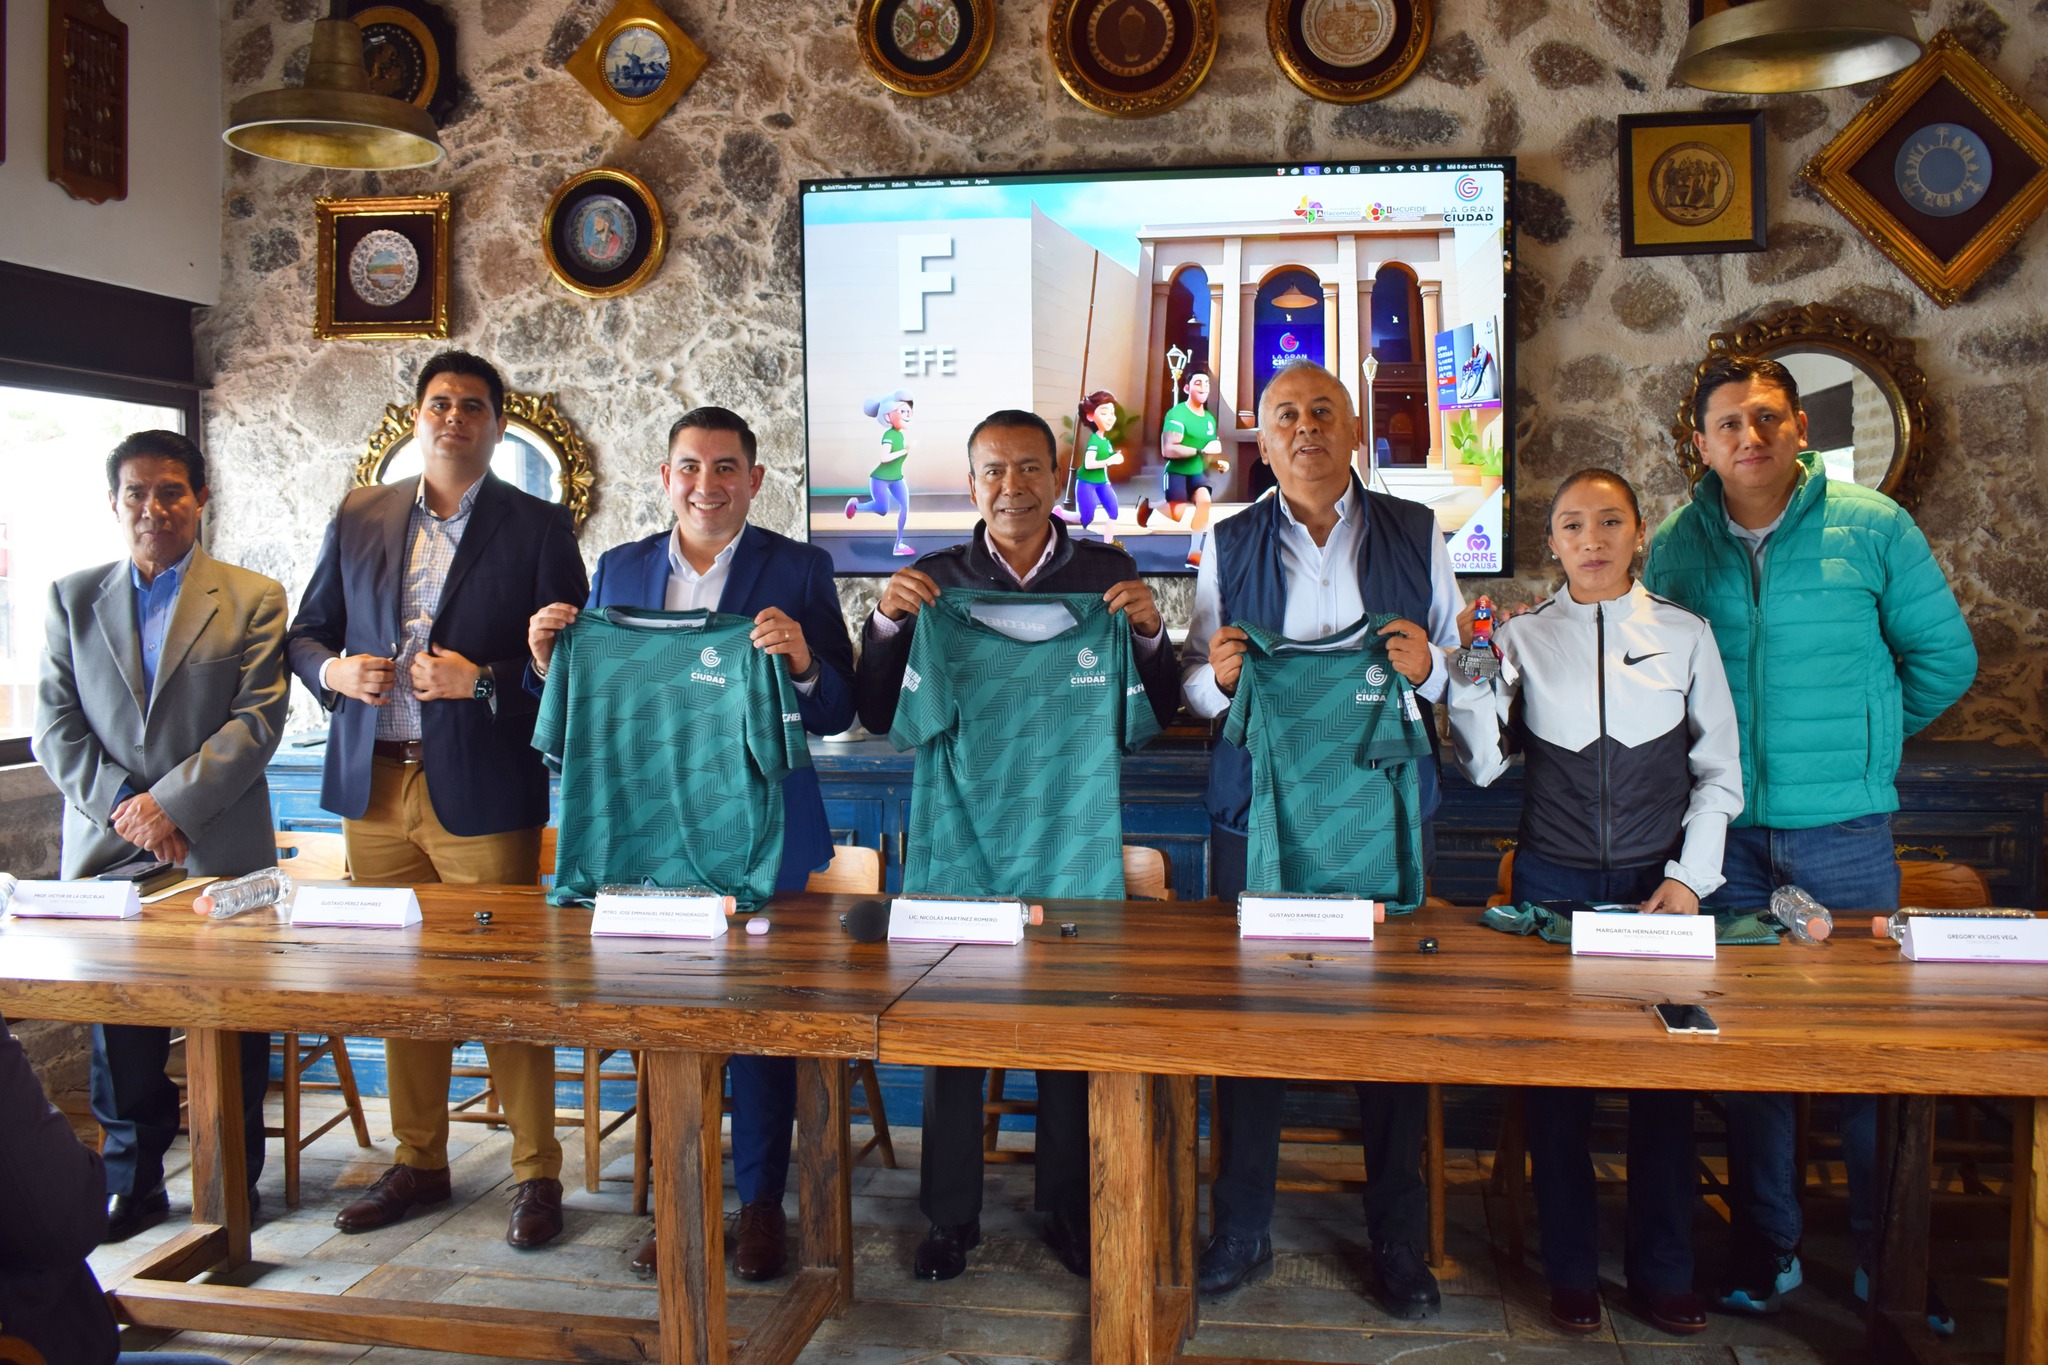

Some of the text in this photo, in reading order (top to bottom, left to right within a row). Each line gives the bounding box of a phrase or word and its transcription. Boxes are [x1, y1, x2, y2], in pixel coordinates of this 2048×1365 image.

[1461, 205, 1494, 213] GRAN
[1444, 213, 1494, 222] CIUDAD
[898, 233, 954, 333] F
[902, 345, 956, 376] EFE
[1453, 552, 1497, 562] CORRE
[690, 672, 726, 684] CIUDAD
[1070, 675, 1106, 685] CIUDAD
[1355, 694, 1387, 702] CIUDA
